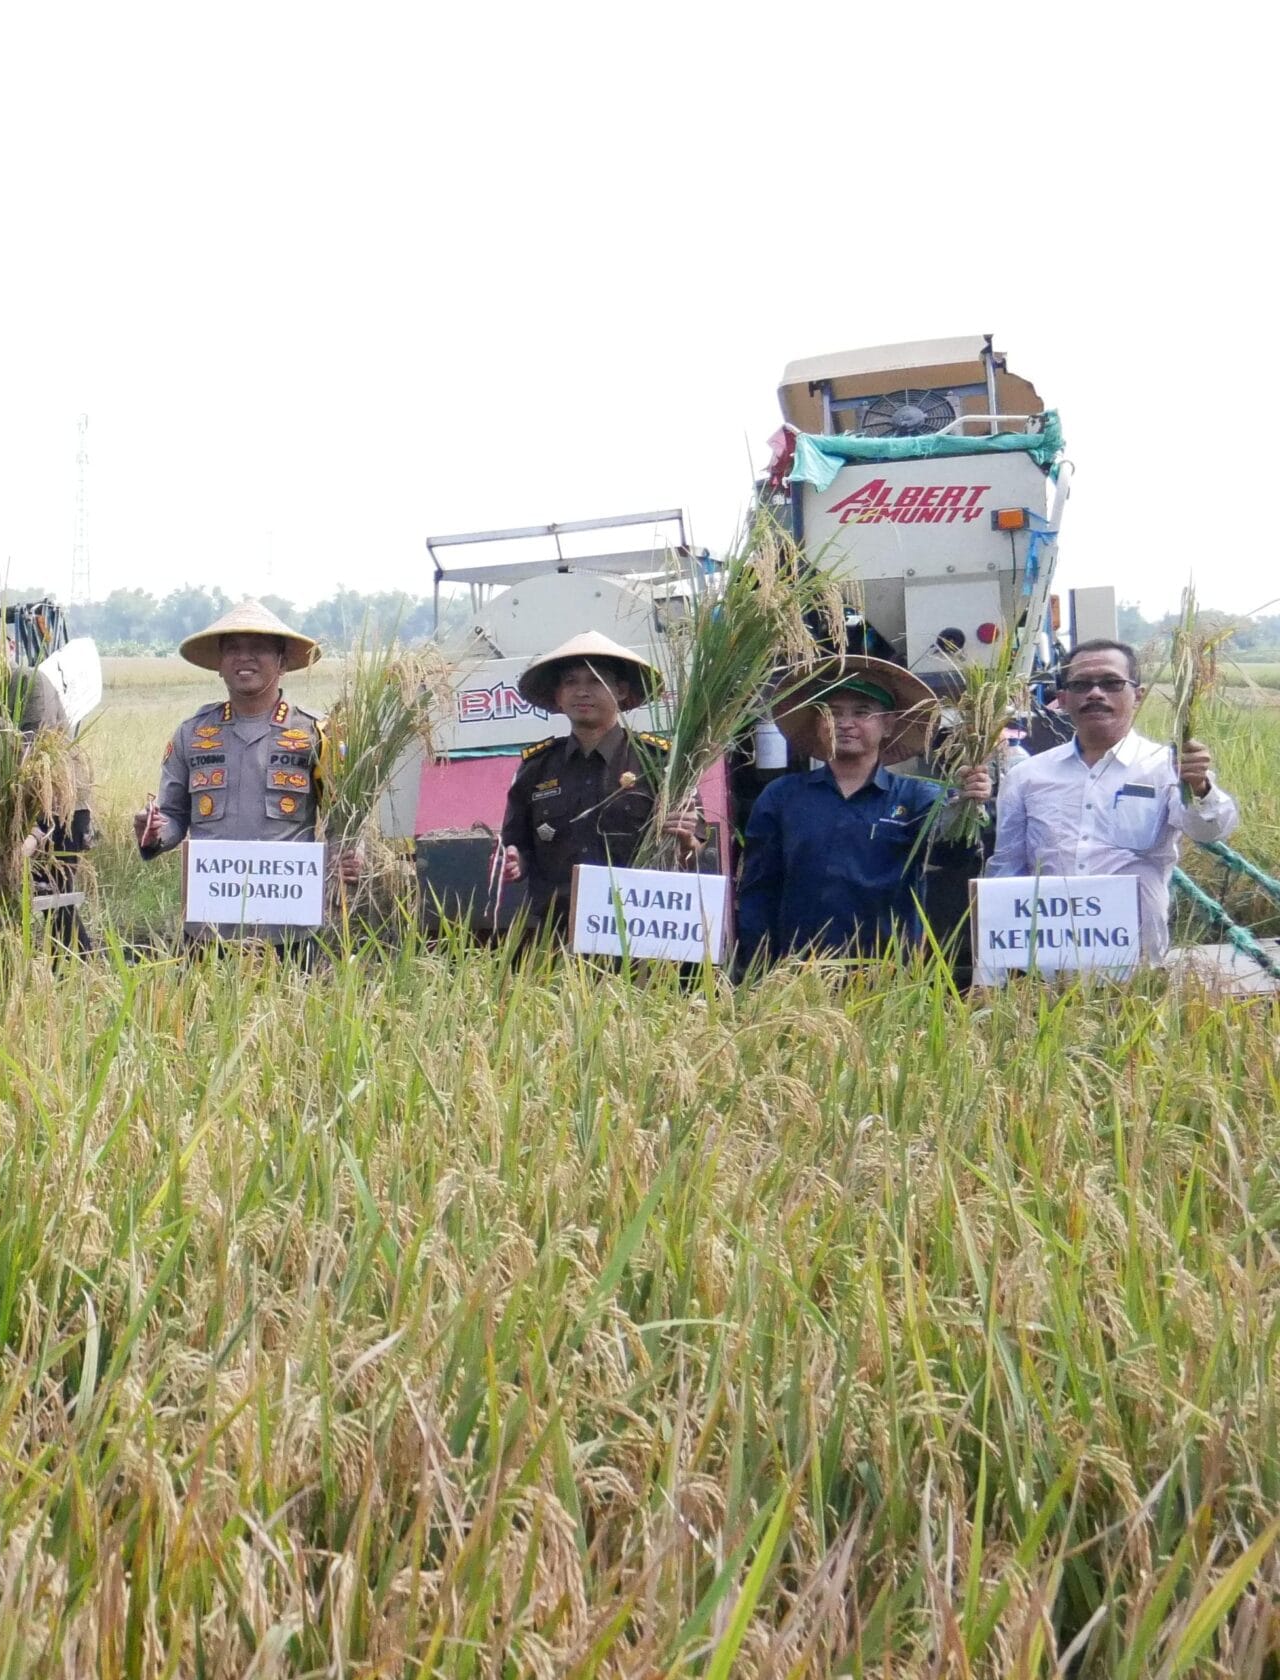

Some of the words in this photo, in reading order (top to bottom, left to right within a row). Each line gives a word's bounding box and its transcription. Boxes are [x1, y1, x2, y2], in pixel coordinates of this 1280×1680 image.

[825, 479, 992, 513] ALBERT
[839, 507, 984, 524] COMUNITY
[195, 858, 318, 876] KAPOLRESTA
[208, 882, 303, 900] SIDOARJO
[1014, 896, 1102, 918] KADES
[989, 926, 1130, 949] KEMUNING
